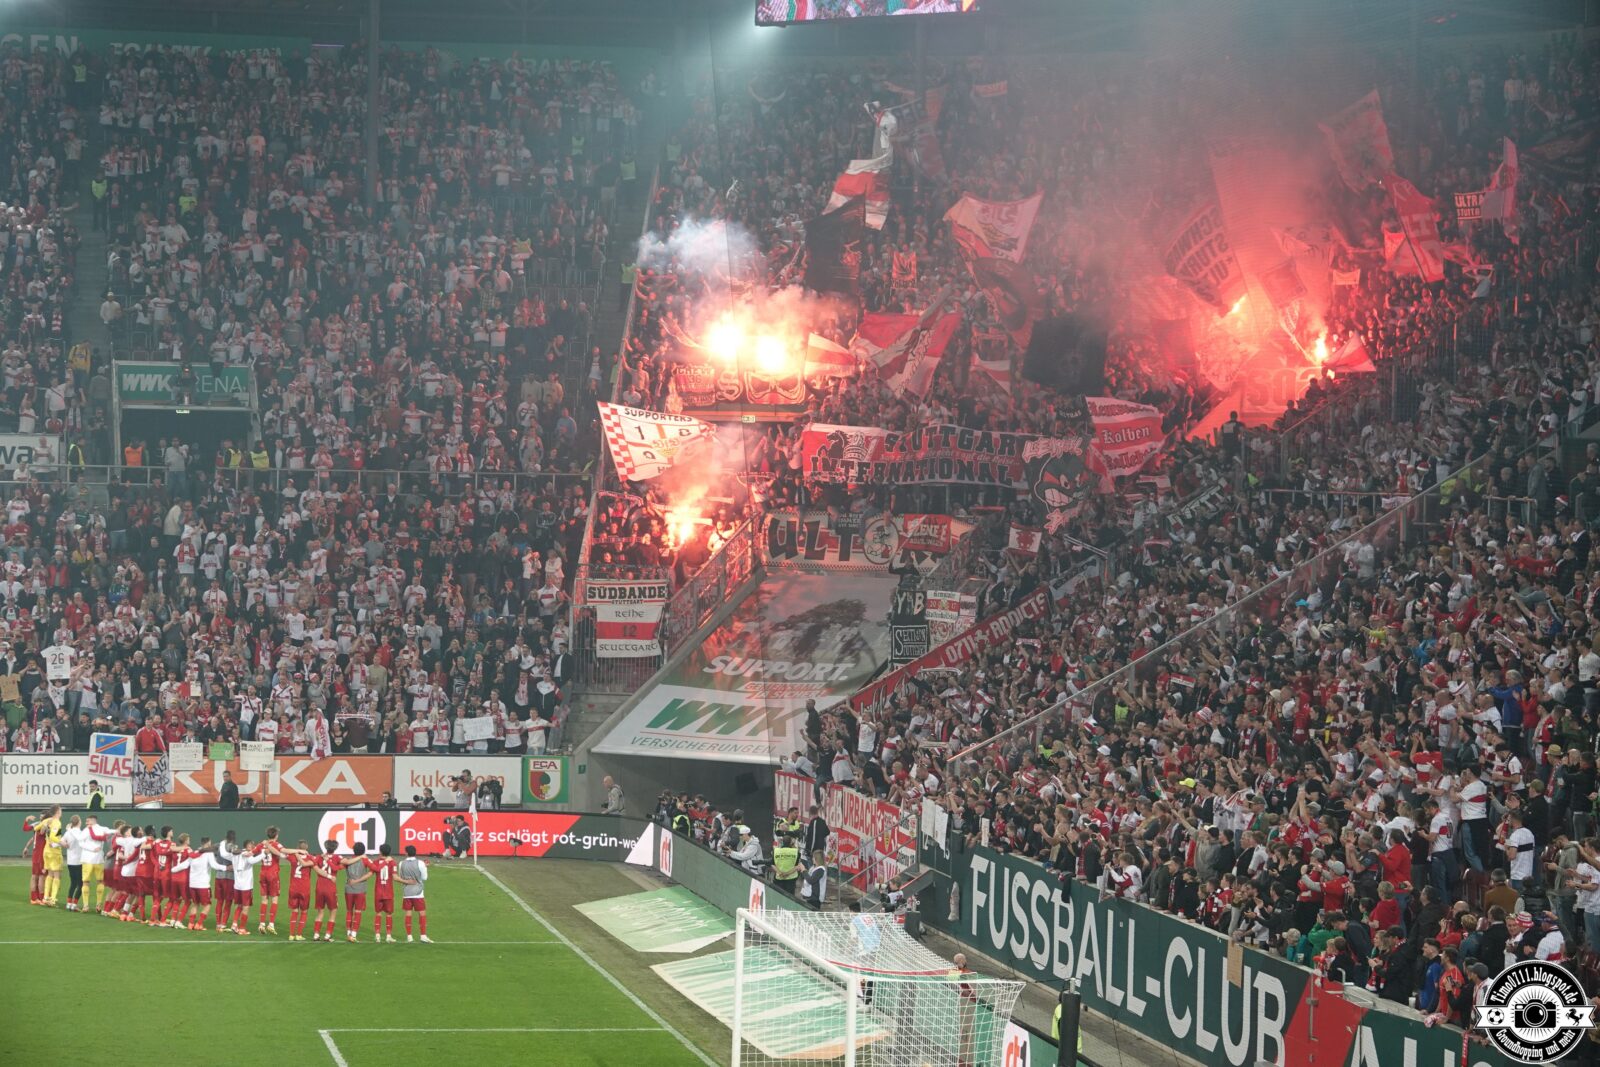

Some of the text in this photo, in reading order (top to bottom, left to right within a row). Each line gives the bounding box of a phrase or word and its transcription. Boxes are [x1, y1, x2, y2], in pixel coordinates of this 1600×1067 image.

[122, 374, 173, 391] WWK
[624, 406, 693, 422] SUPPORTERS
[883, 424, 1022, 452] STUTTGAR
[810, 456, 1012, 487] INTERNATIONAL
[588, 586, 667, 600] SÜDBANDE
[945, 635, 976, 663] 0711
[51, 653, 64, 664] 26
[645, 698, 808, 737] WWK
[630, 736, 777, 754] VERSICHERUNGEN
[533, 760, 557, 769] FCA
[410, 770, 504, 787] kukaom
[16, 780, 114, 796] #innovaton
[405, 828, 442, 841] Dein
[488, 829, 548, 847] schlägt
[553, 833, 638, 850] rot-grün-we
[970, 854, 1286, 1067] FUSSBALL-CLUB
